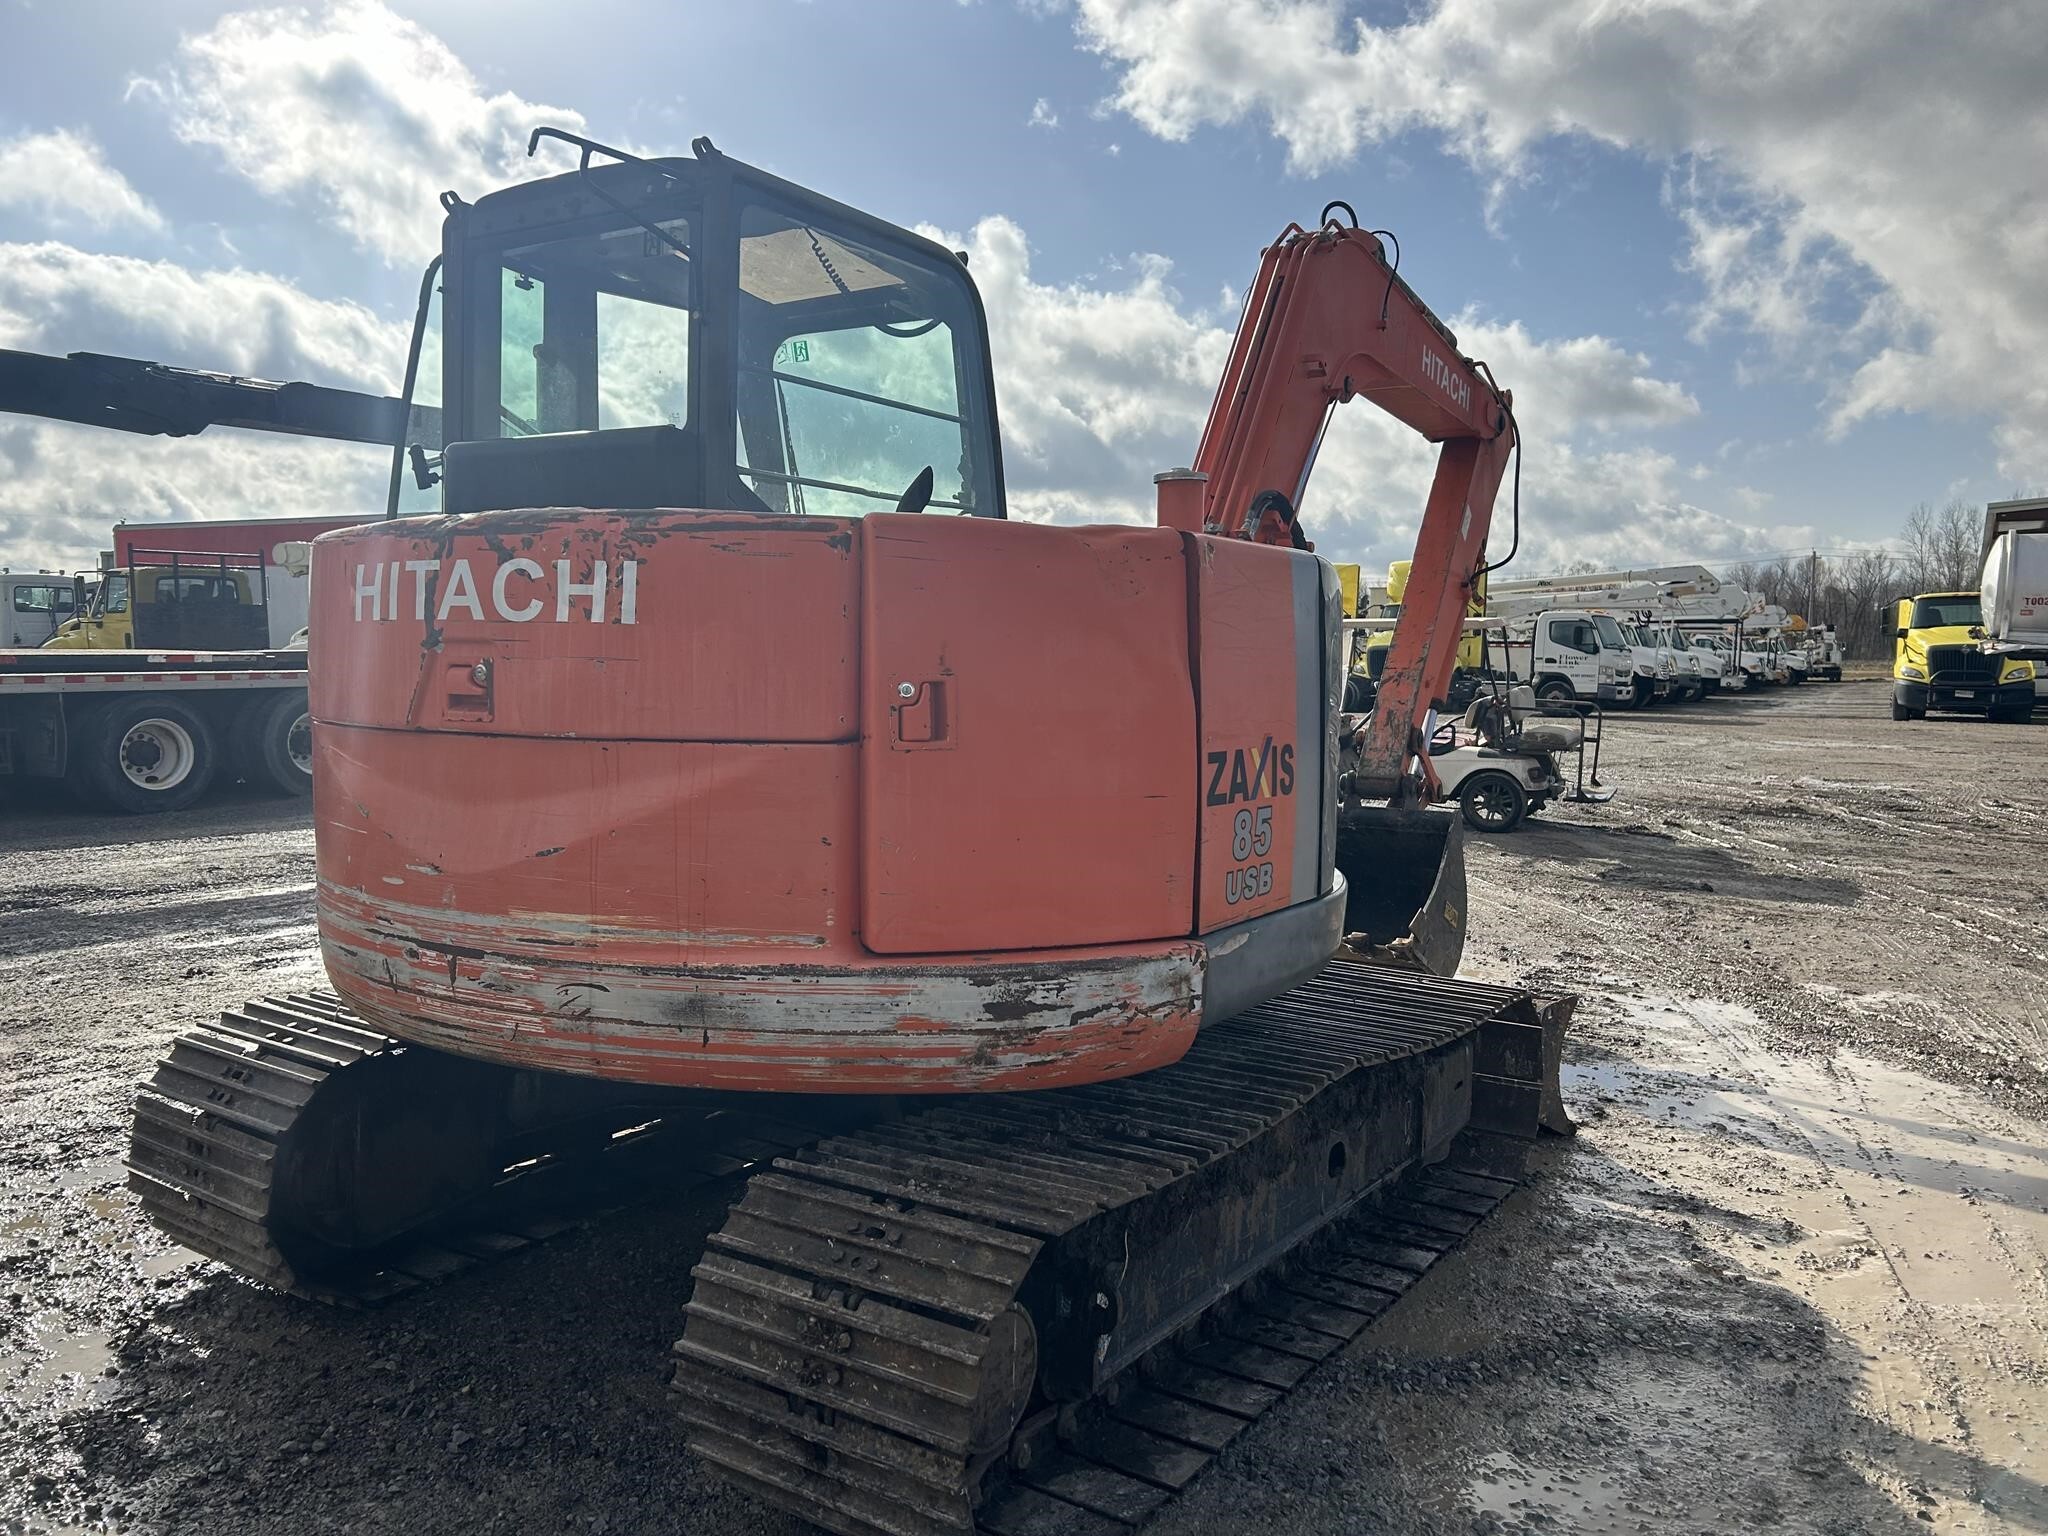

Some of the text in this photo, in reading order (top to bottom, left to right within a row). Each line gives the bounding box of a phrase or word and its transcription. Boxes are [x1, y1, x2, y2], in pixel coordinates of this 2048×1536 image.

[1422, 344, 1470, 412] HITACHI
[355, 558, 638, 624] HITACHI
[1207, 735, 1294, 806] ZAXIS
[1232, 805, 1273, 862] 85
[1225, 862, 1273, 905] USB
